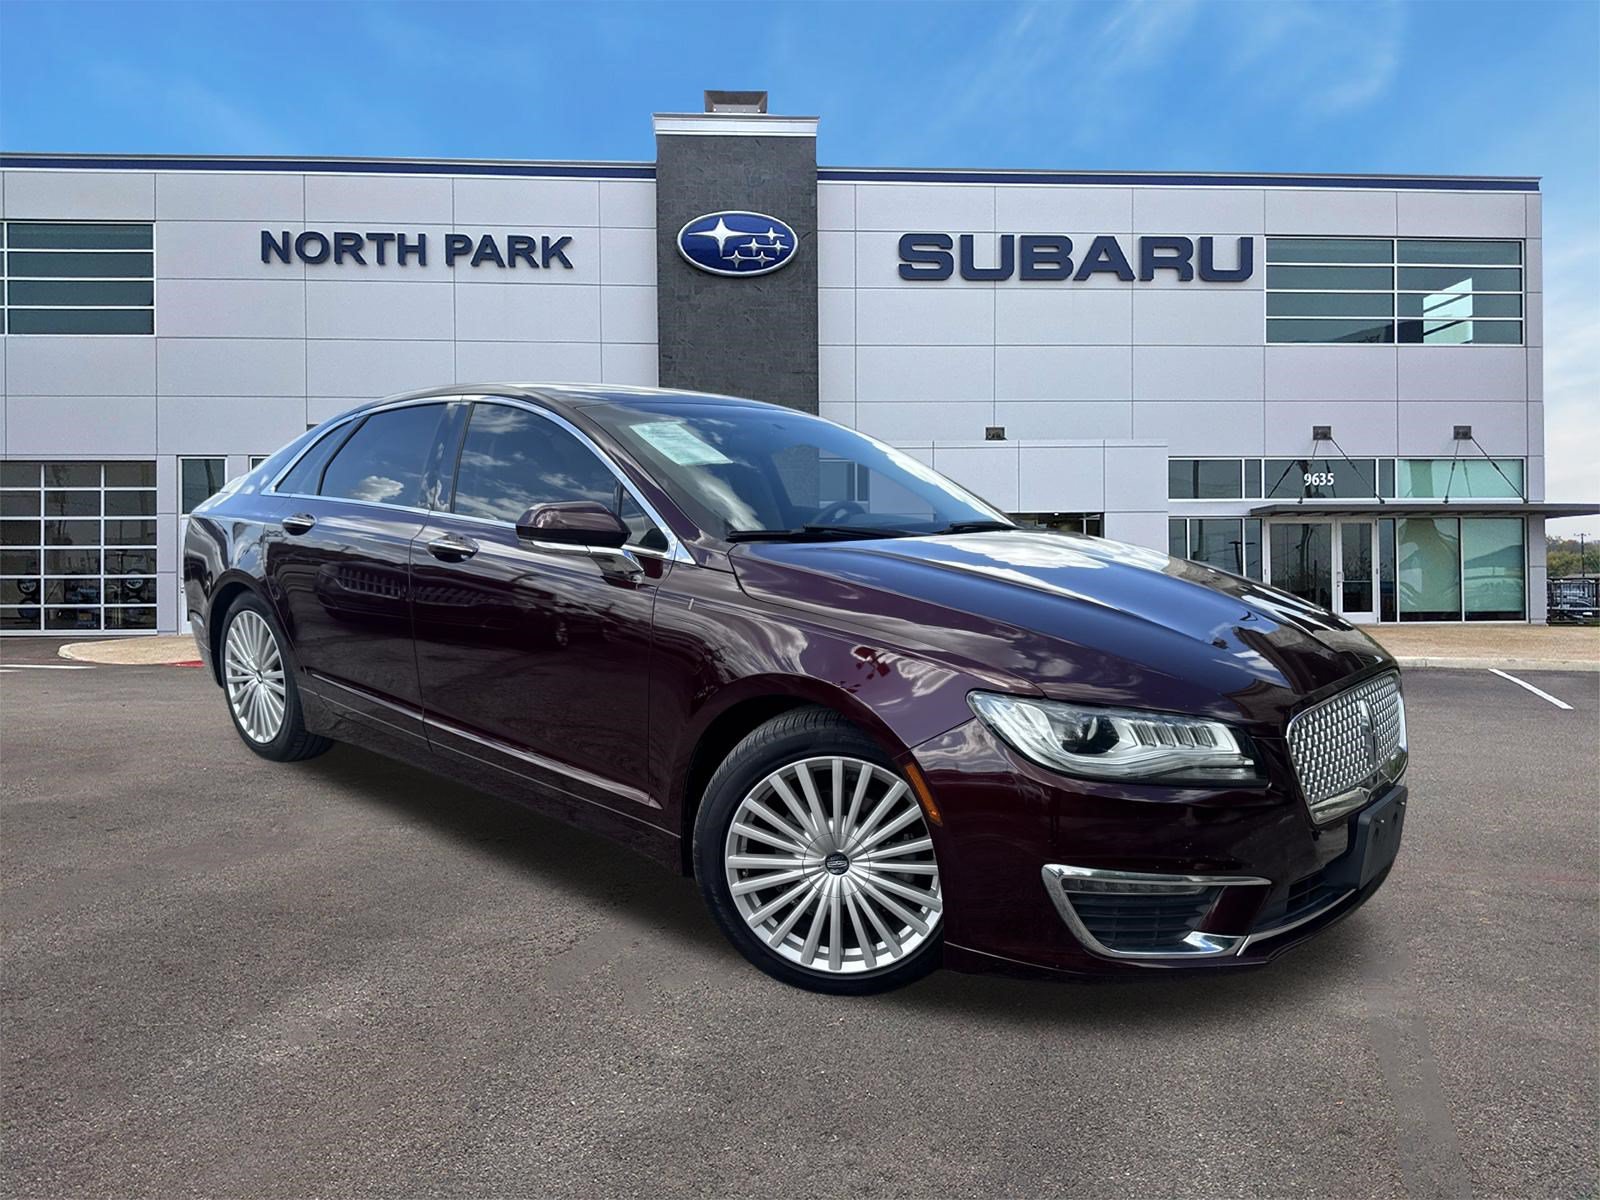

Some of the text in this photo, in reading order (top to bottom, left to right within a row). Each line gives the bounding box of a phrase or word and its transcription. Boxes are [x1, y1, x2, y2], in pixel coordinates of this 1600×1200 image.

[261, 230, 574, 269] NORTH PARK
[898, 233, 1254, 282] SUBARU
[1303, 472, 1335, 486] 9635
